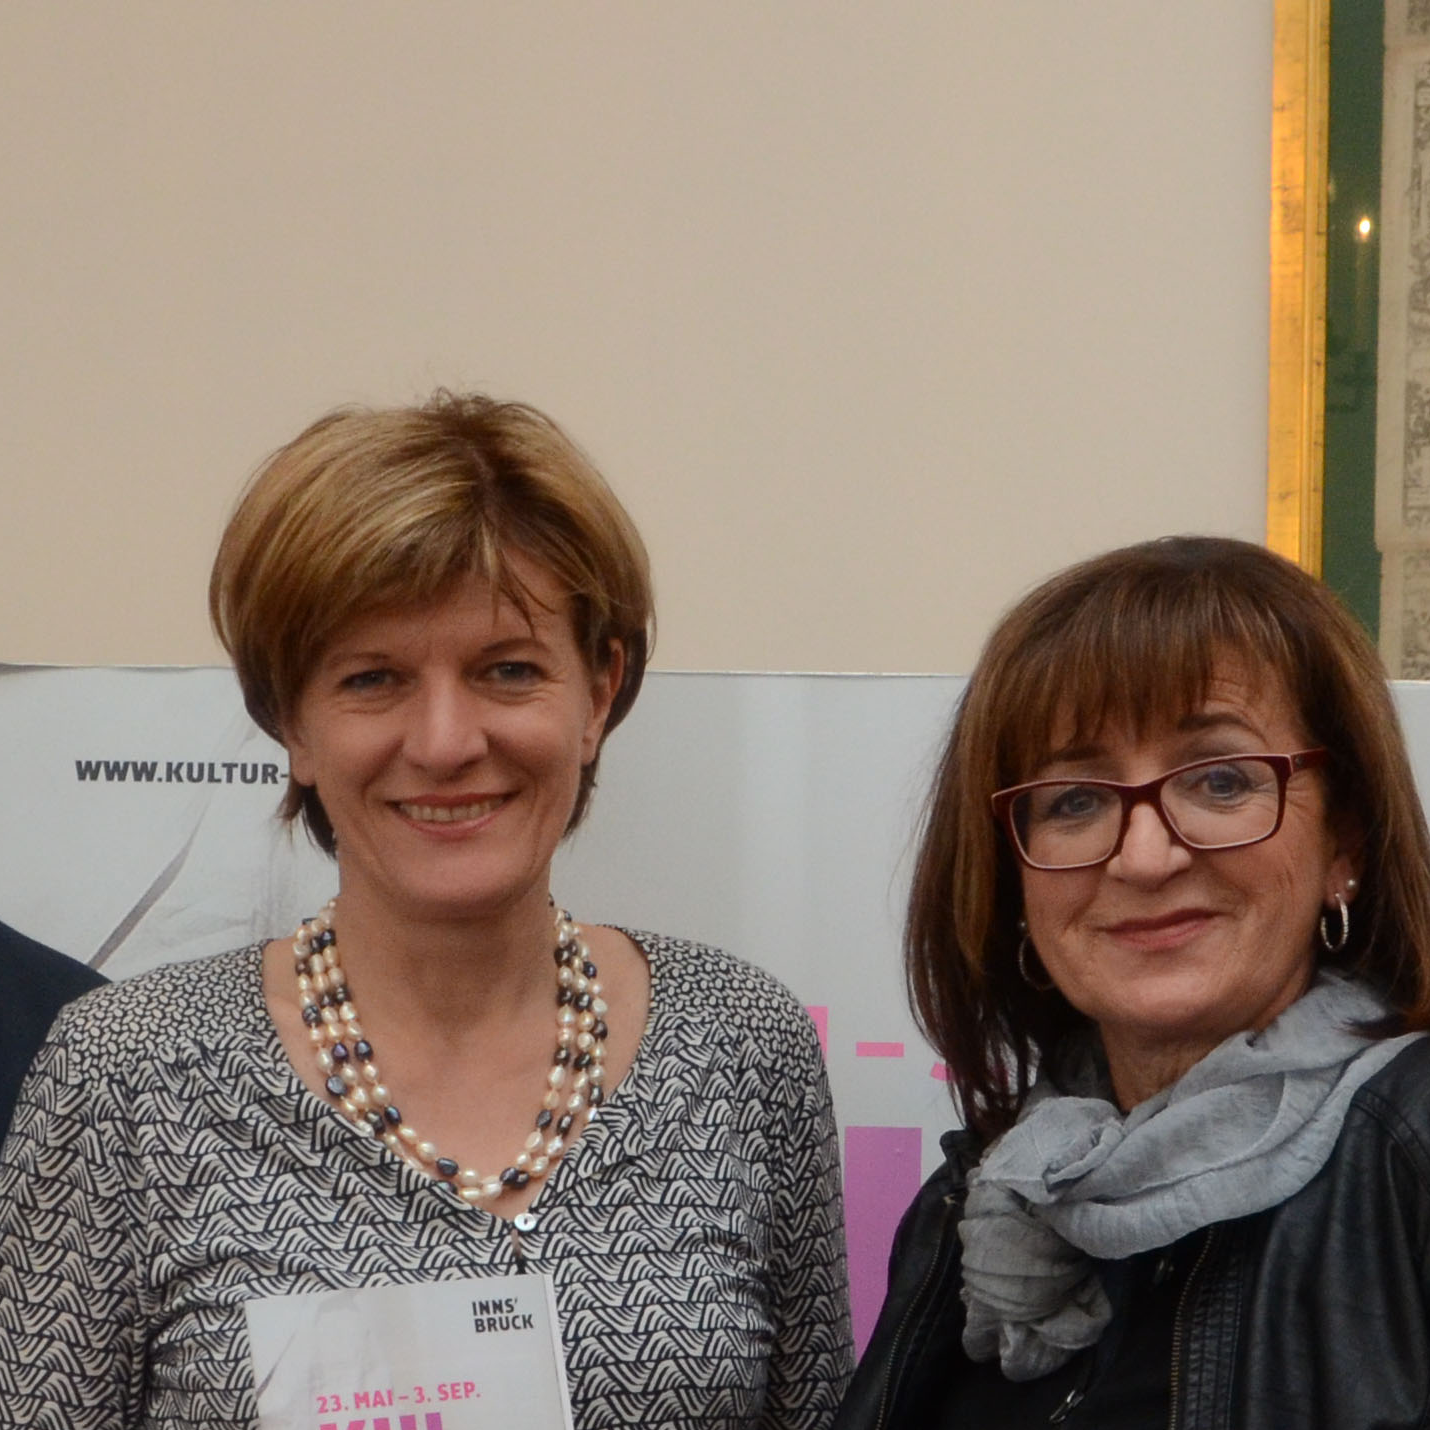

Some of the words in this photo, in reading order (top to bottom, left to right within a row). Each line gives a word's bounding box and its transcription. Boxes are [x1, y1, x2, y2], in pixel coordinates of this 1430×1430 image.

[471, 1298, 520, 1317] INNS'
[474, 1313, 535, 1335] BRUCK
[316, 1394, 351, 1414] 23.
[354, 1390, 395, 1409] MAI
[413, 1386, 433, 1404] 3.
[437, 1381, 482, 1401] SEP.
